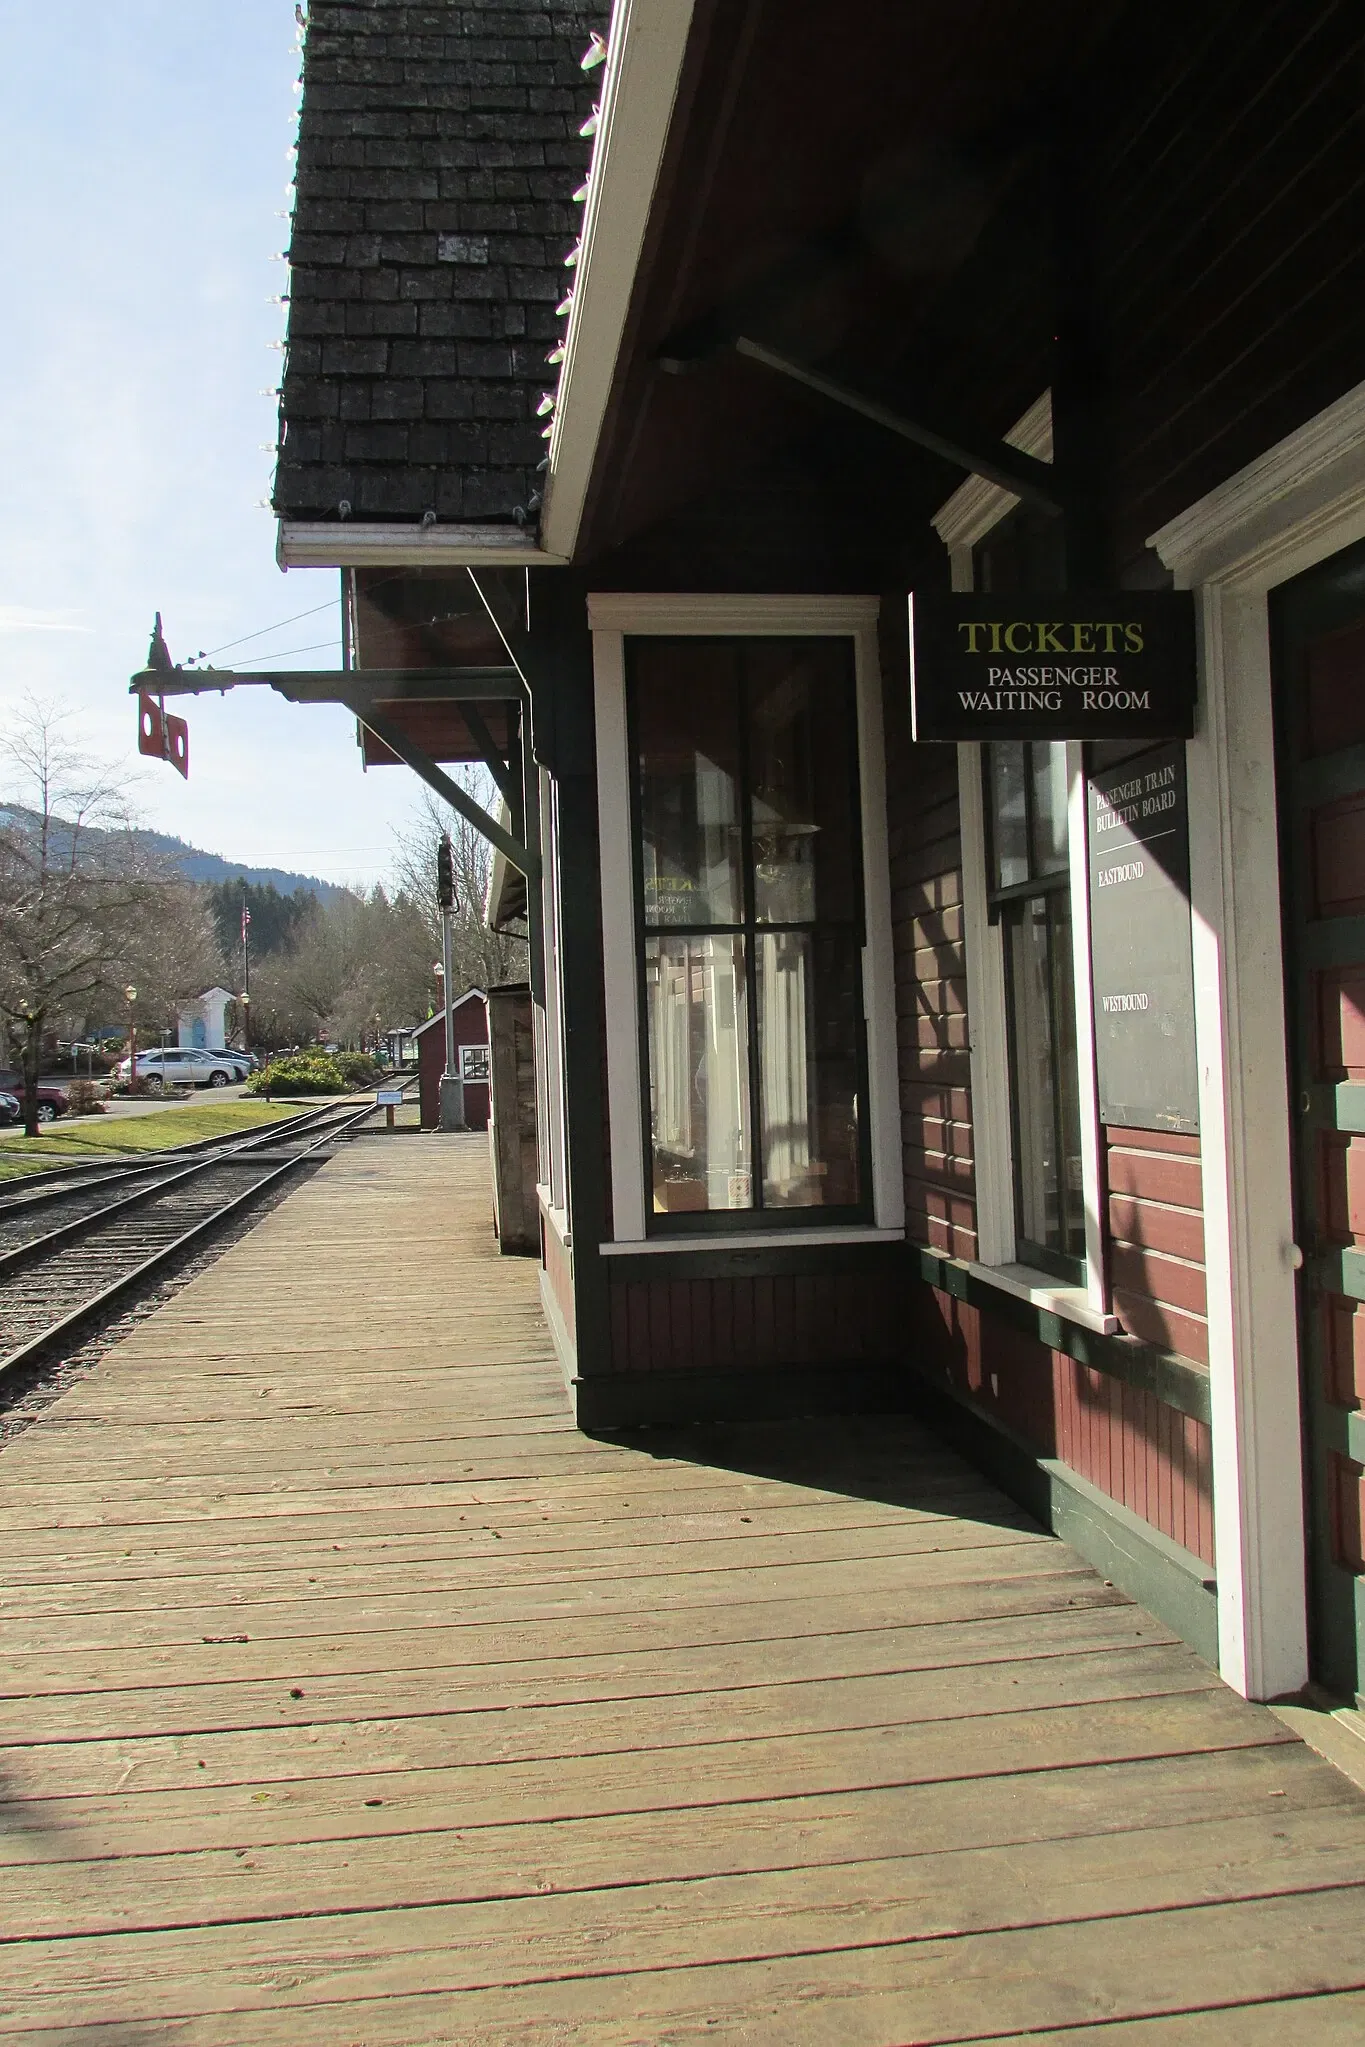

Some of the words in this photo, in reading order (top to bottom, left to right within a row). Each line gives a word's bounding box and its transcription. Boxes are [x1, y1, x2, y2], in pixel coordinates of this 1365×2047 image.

[958, 622, 1145, 654] TICKETS
[987, 667, 1120, 686] PASSENGER
[958, 691, 1063, 711] WAITING
[1081, 691, 1151, 710] ROOM
[1096, 778, 1143, 811] PASSENGER
[1144, 764, 1176, 793] TRAIN
[1096, 803, 1140, 833] BULLETIN
[1142, 790, 1176, 817] BOARD
[1098, 861, 1144, 887] EASTBOUND
[1102, 993, 1149, 1012] WESTBOUND
